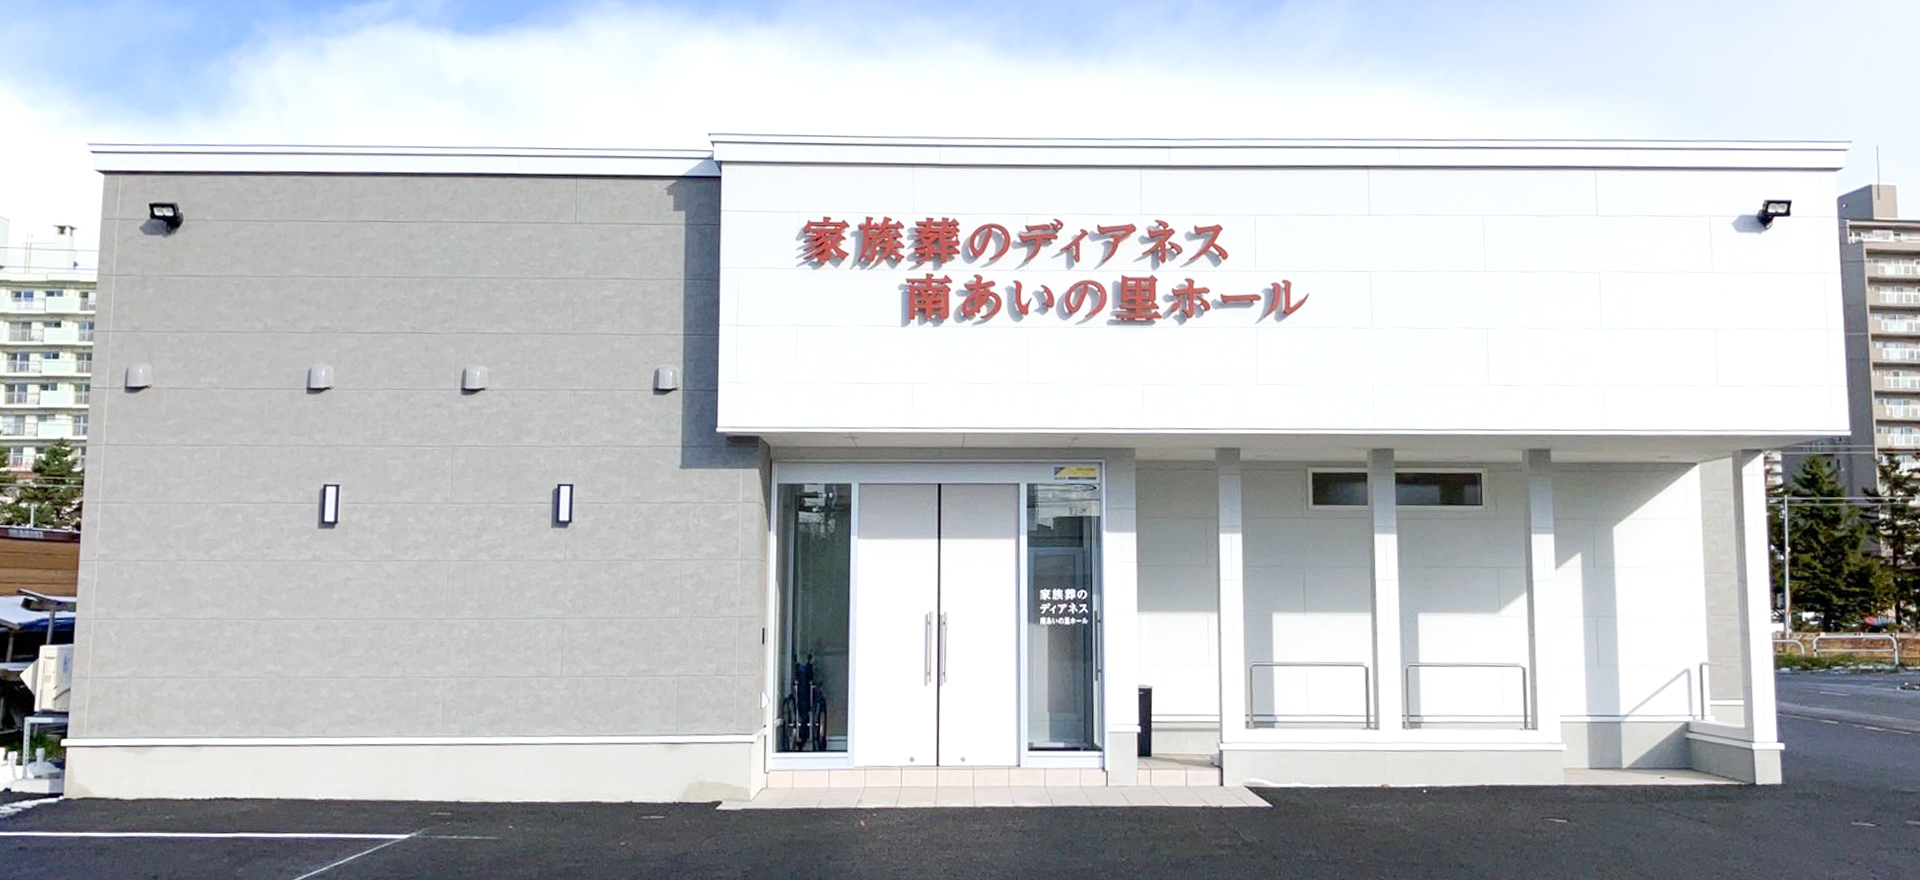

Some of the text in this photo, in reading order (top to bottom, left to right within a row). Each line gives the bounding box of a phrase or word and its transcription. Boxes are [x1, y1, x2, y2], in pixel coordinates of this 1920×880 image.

[803, 216, 1229, 264] 家族葬のディアネス
[906, 274, 1309, 321] 南あいの里ホール
[1039, 588, 1088, 601] 家族葬の
[1039, 602, 1089, 615] ディアネス
